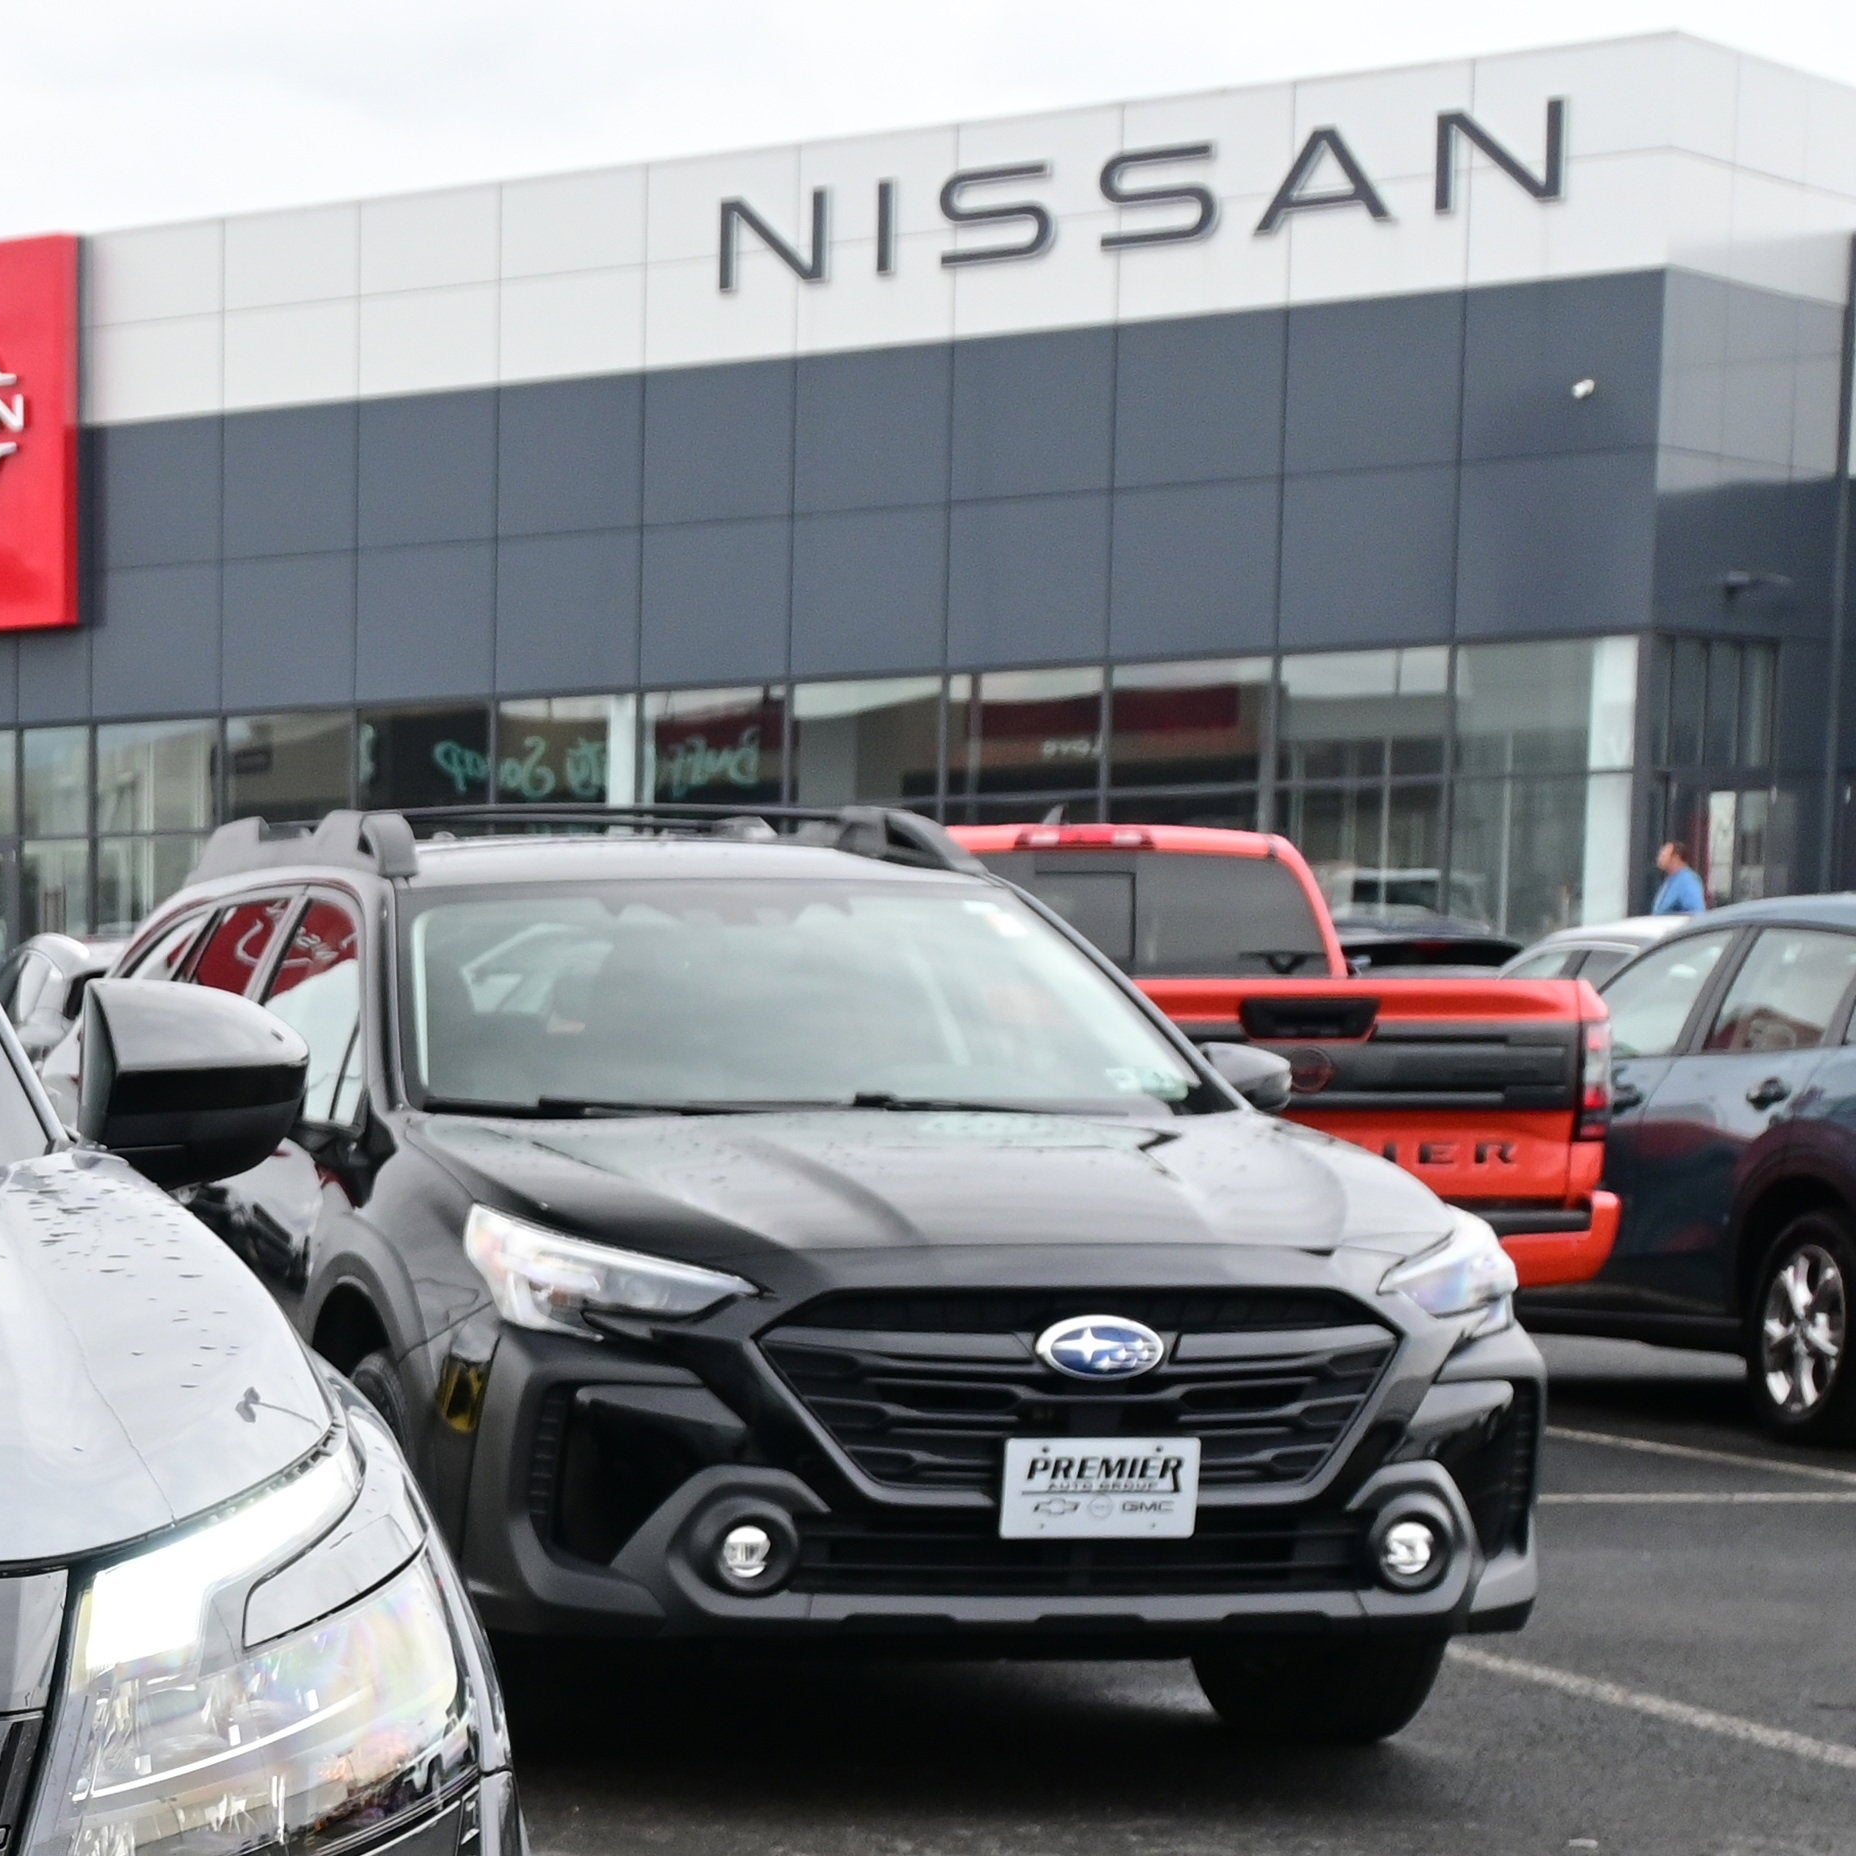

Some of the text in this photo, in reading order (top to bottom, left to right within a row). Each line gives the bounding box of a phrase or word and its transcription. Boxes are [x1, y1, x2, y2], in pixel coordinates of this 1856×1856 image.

[717, 94, 1570, 292] NISSAN
[1026, 1456, 1184, 1491] PREMIER
[1047, 1482, 1159, 1491] AUTO GROUP
[1121, 1500, 1175, 1513] GMC
